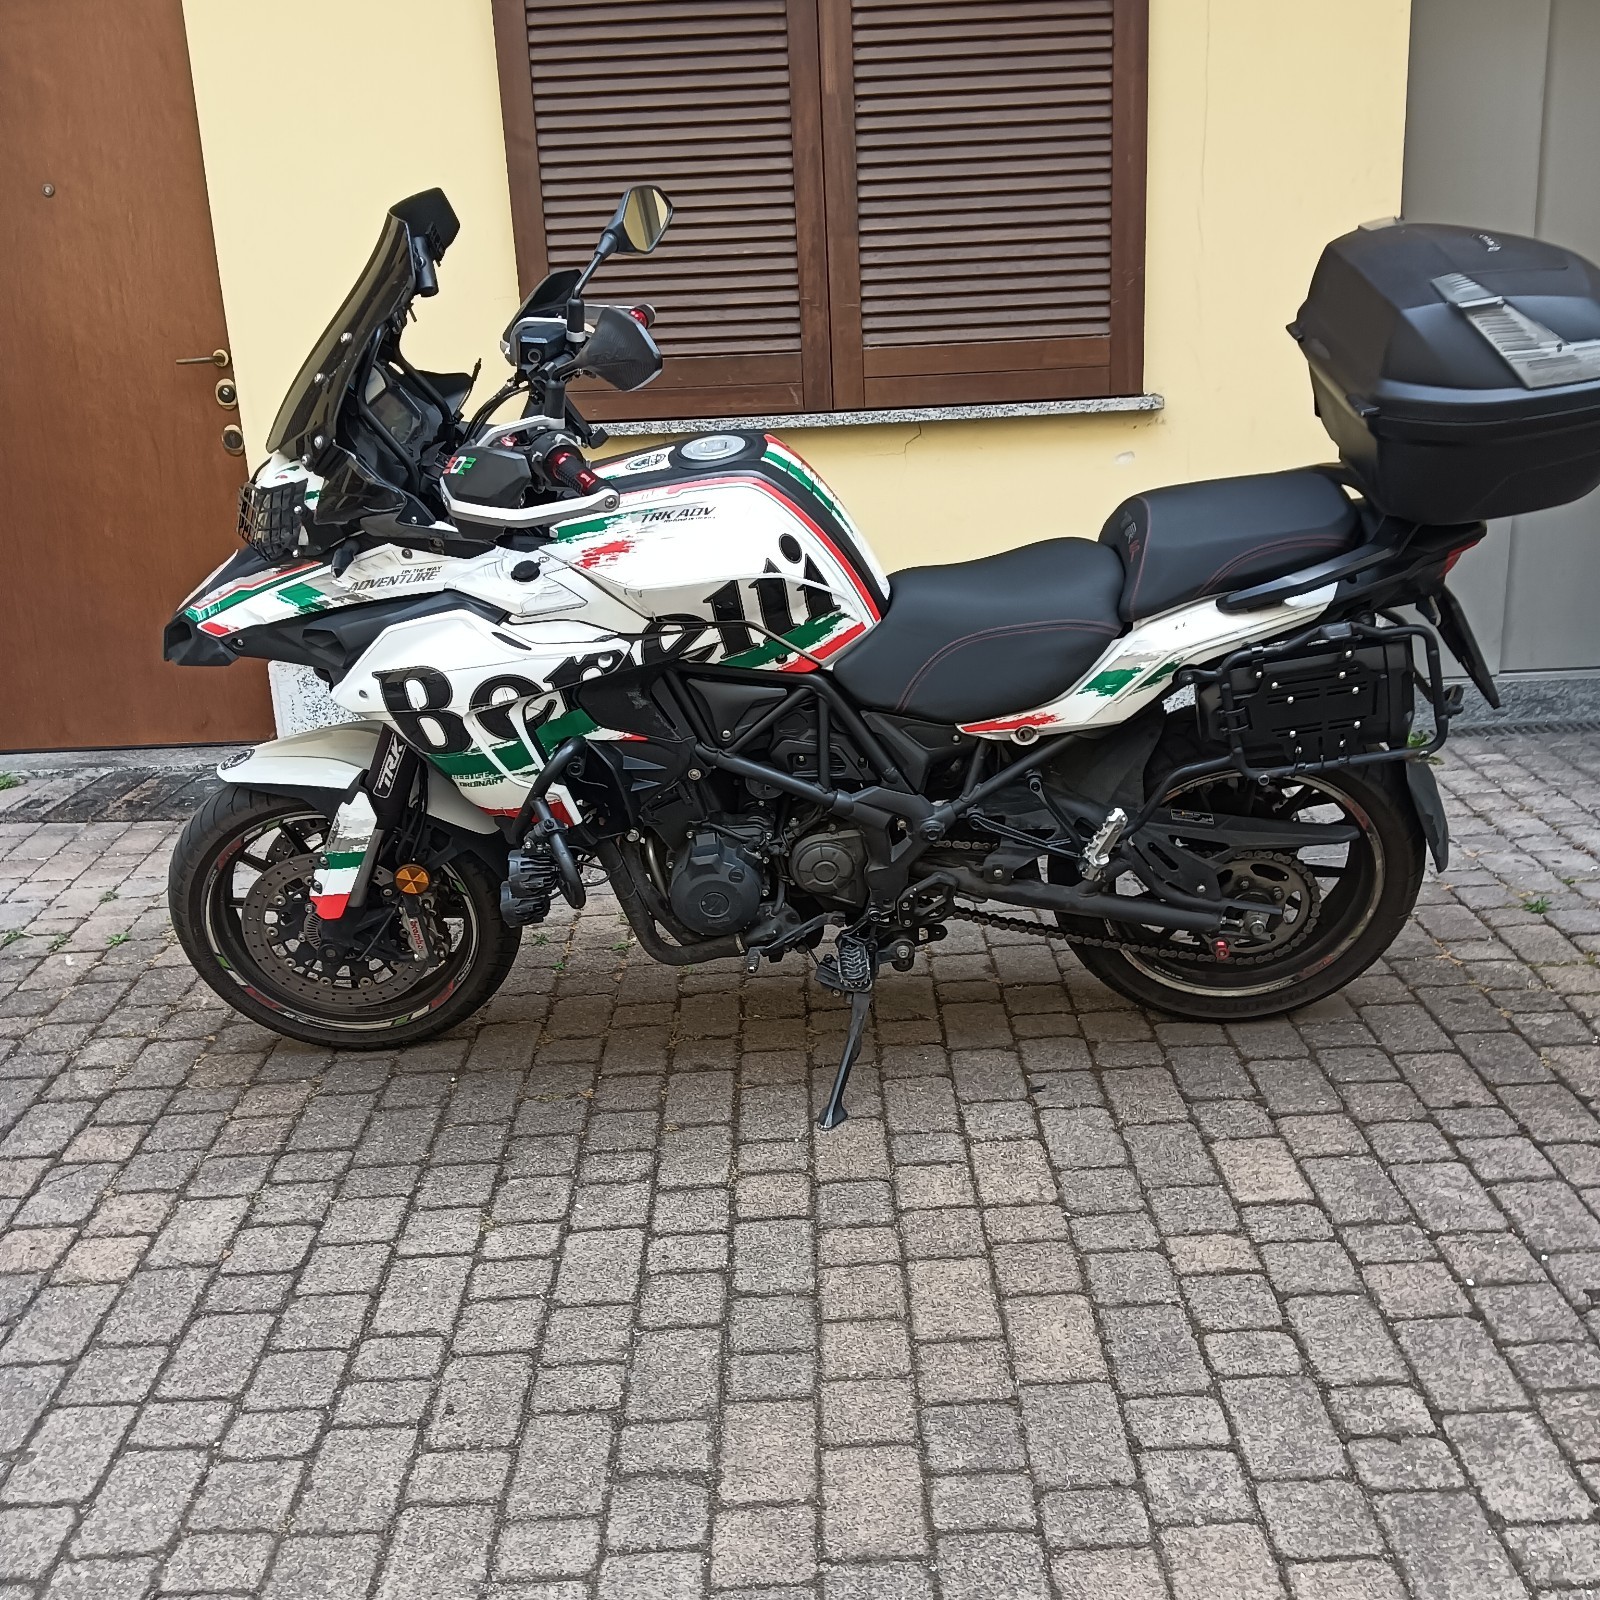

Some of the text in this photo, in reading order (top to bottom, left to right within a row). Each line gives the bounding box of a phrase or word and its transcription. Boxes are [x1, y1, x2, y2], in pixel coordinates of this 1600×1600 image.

[641, 510, 676, 523] TRK
[676, 506, 717, 518] ADV
[349, 571, 438, 592] ADVENTURE
[377, 734, 405, 790] TRK
